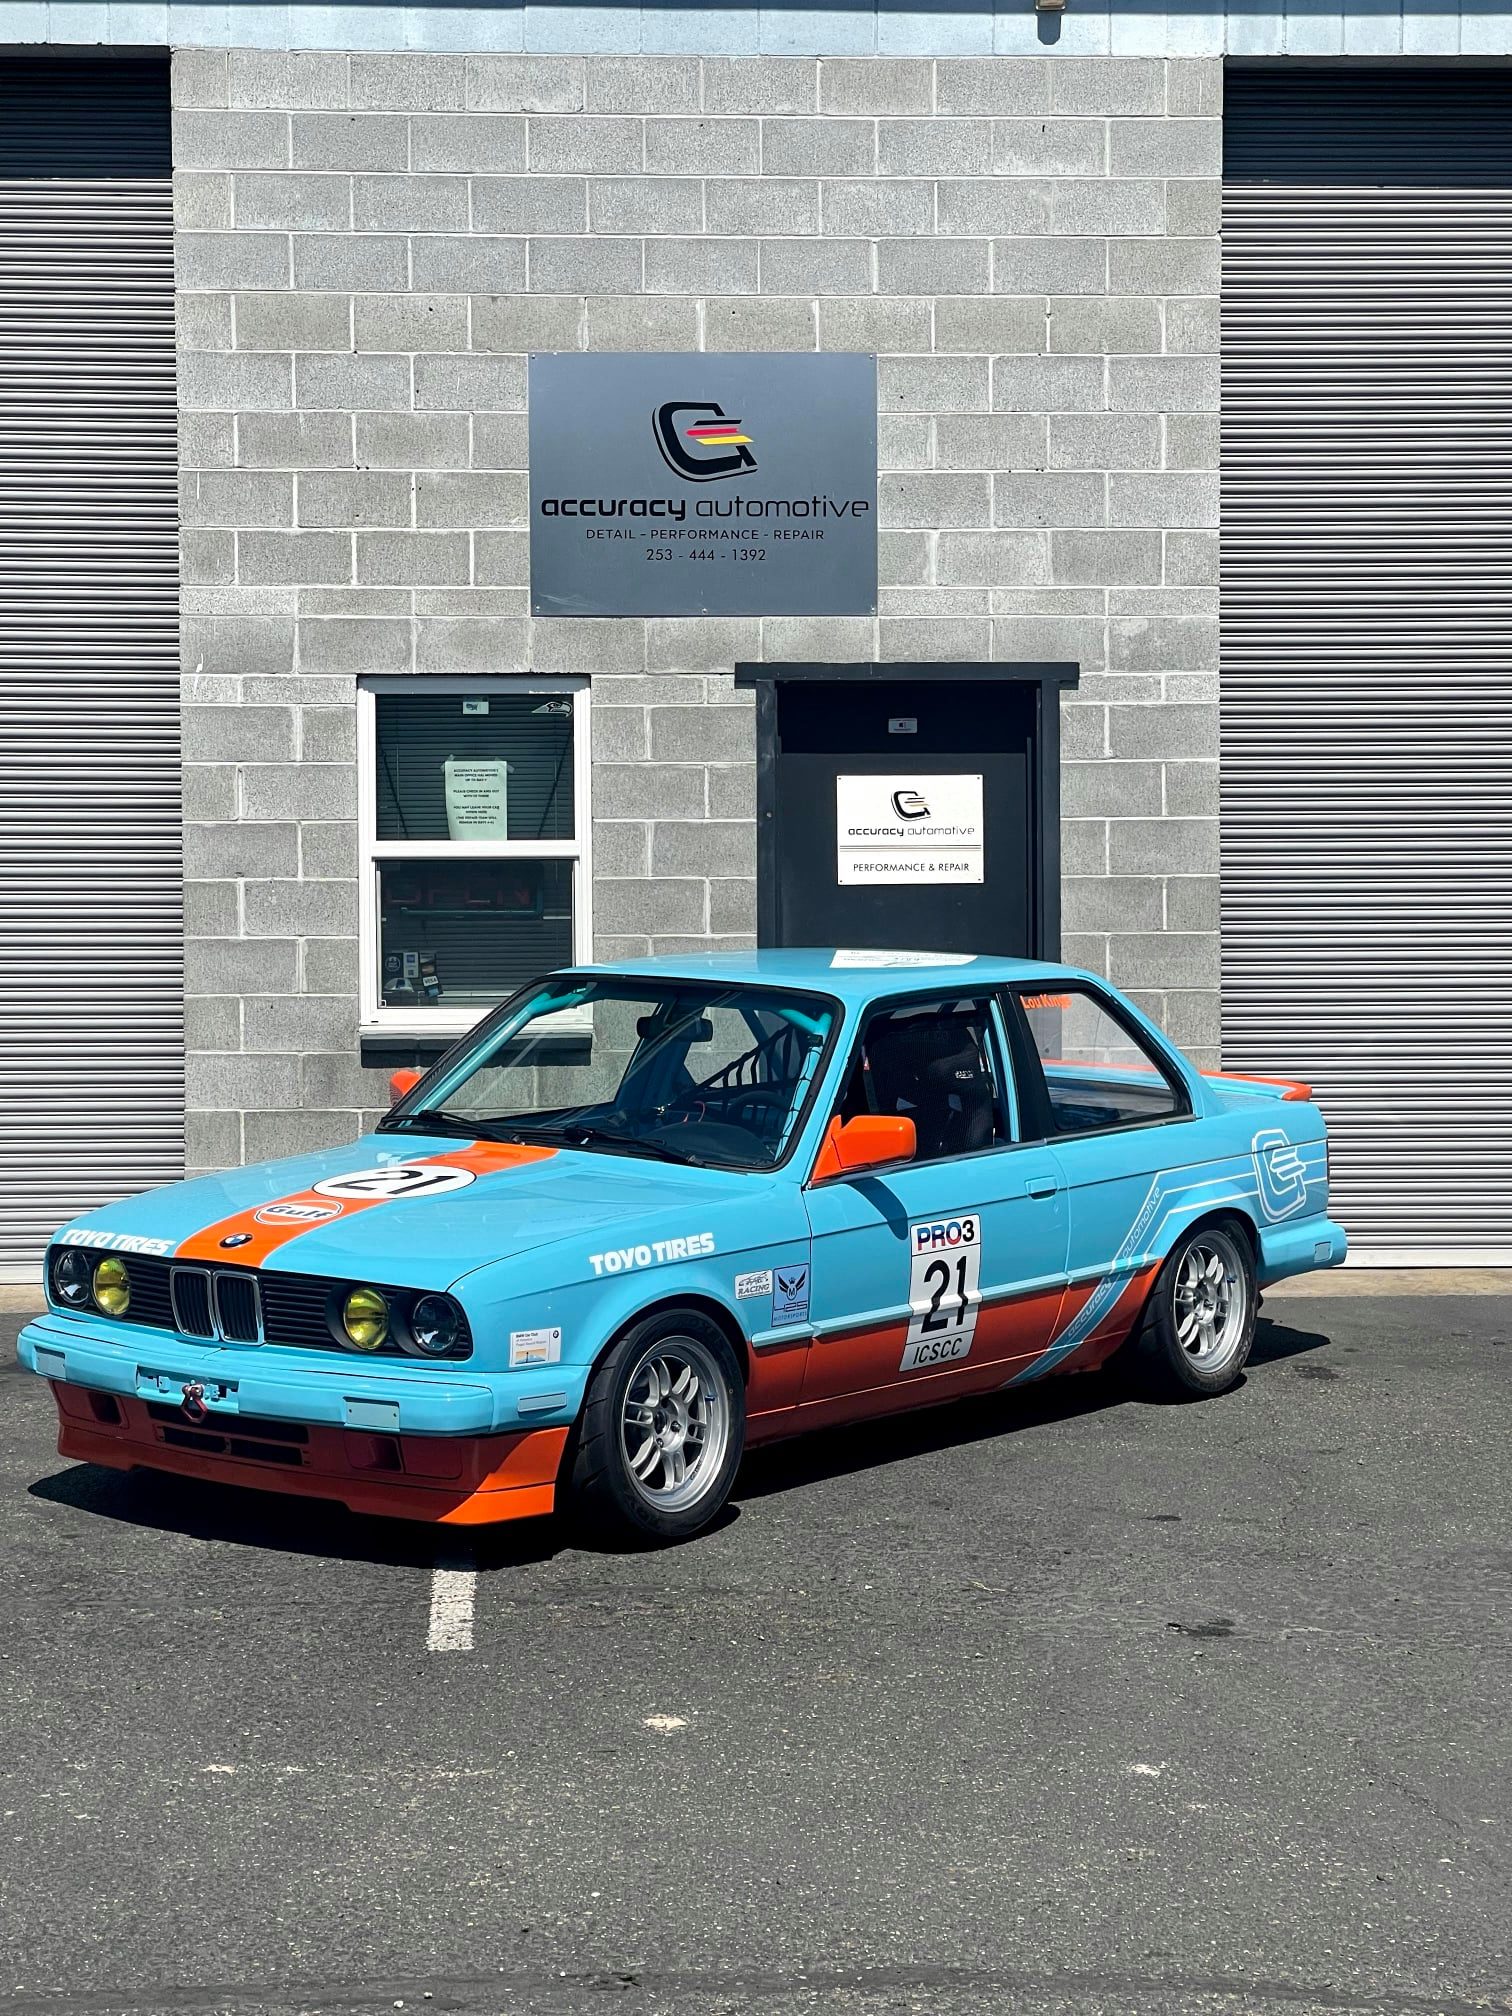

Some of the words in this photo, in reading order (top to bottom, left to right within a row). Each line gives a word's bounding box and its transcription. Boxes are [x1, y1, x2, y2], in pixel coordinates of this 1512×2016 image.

[541, 498, 686, 522] accuracy
[695, 495, 869, 518] automotive
[586, 528, 636, 540] DETAIL
[650, 528, 759, 540] PERFORMANCE
[773, 528, 824, 540] REPAIR
[646, 548, 673, 561] 253
[689, 548, 715, 561] 444
[732, 548, 766, 561] 1392
[848, 827, 904, 837] accuracy
[907, 826, 975, 836] automotive
[853, 863, 925, 872] PERFORMANCE
[928, 863, 935, 871] &
[938, 863, 970, 871] REPAIR
[327, 1169, 458, 1195] 21
[266, 1205, 333, 1218] Gulf
[60, 1229, 116, 1248] TOYO
[111, 1234, 177, 1256] TIRES
[917, 1219, 975, 1251] PRO3
[589, 1245, 652, 1275] TOYO
[652, 1232, 715, 1262] TIRES
[1068, 1277, 1112, 1338] accuracy
[1122, 1186, 1160, 1258] automotive
[738, 1284, 770, 1295] RACING
[920, 1256, 968, 1333] 21
[912, 1338, 963, 1365] ICSCC
